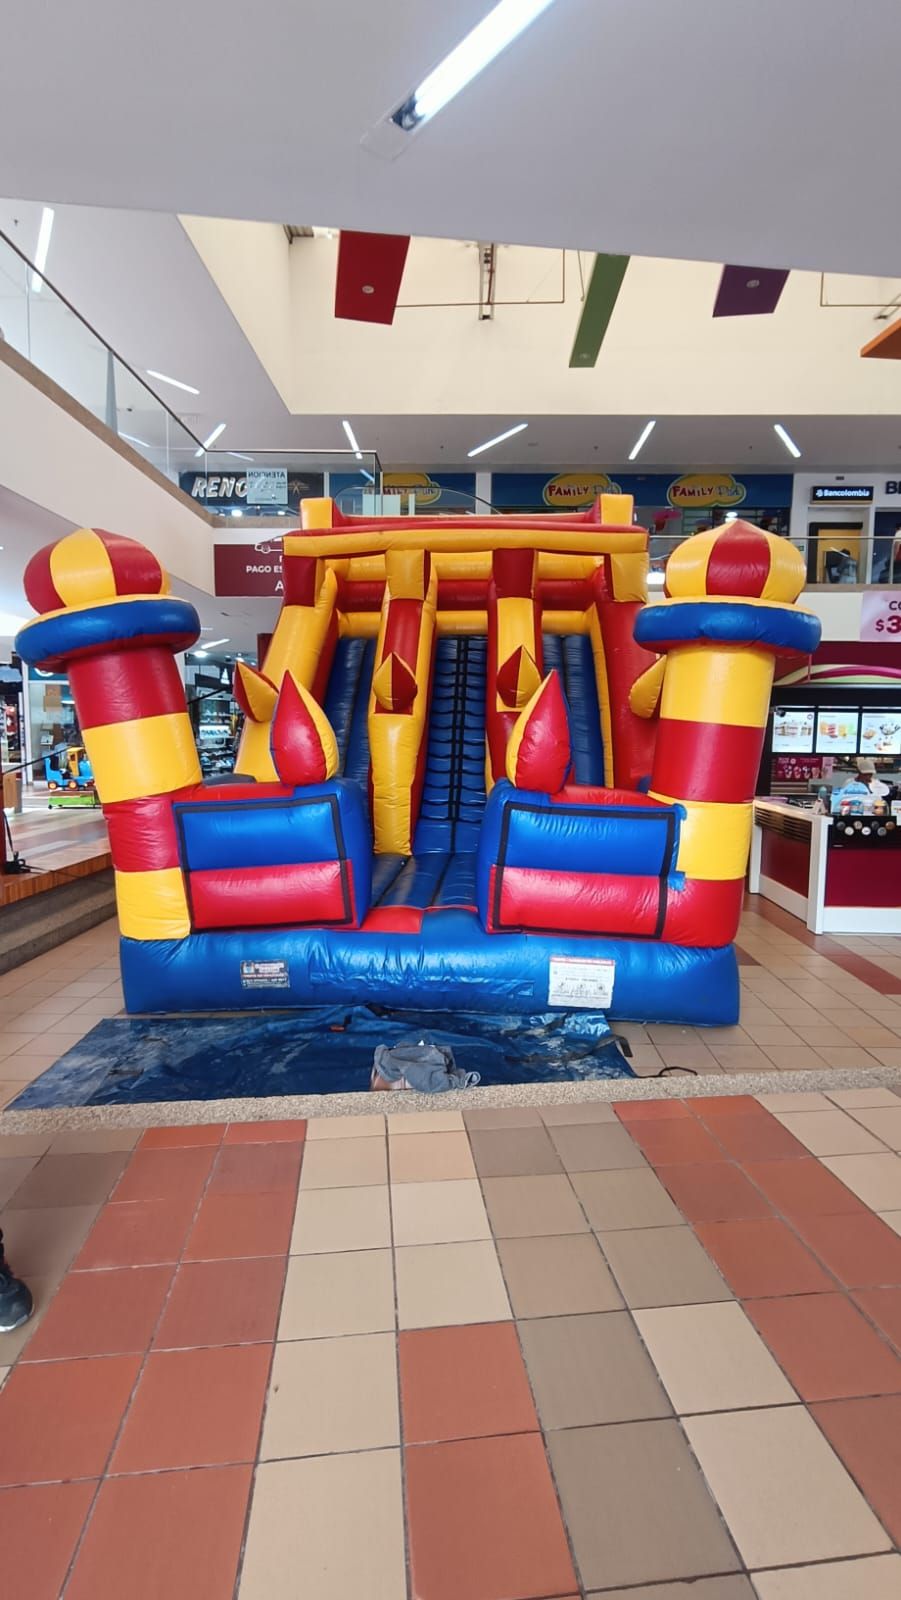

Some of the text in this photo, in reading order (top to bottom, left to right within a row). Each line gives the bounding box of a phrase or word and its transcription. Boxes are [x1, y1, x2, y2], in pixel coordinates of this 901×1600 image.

[547, 484, 590, 497] FAMILY
[672, 485, 714, 498] FAMILY
[823, 489, 870, 497] Bancolombia
[246, 565, 272, 574] PAGO
